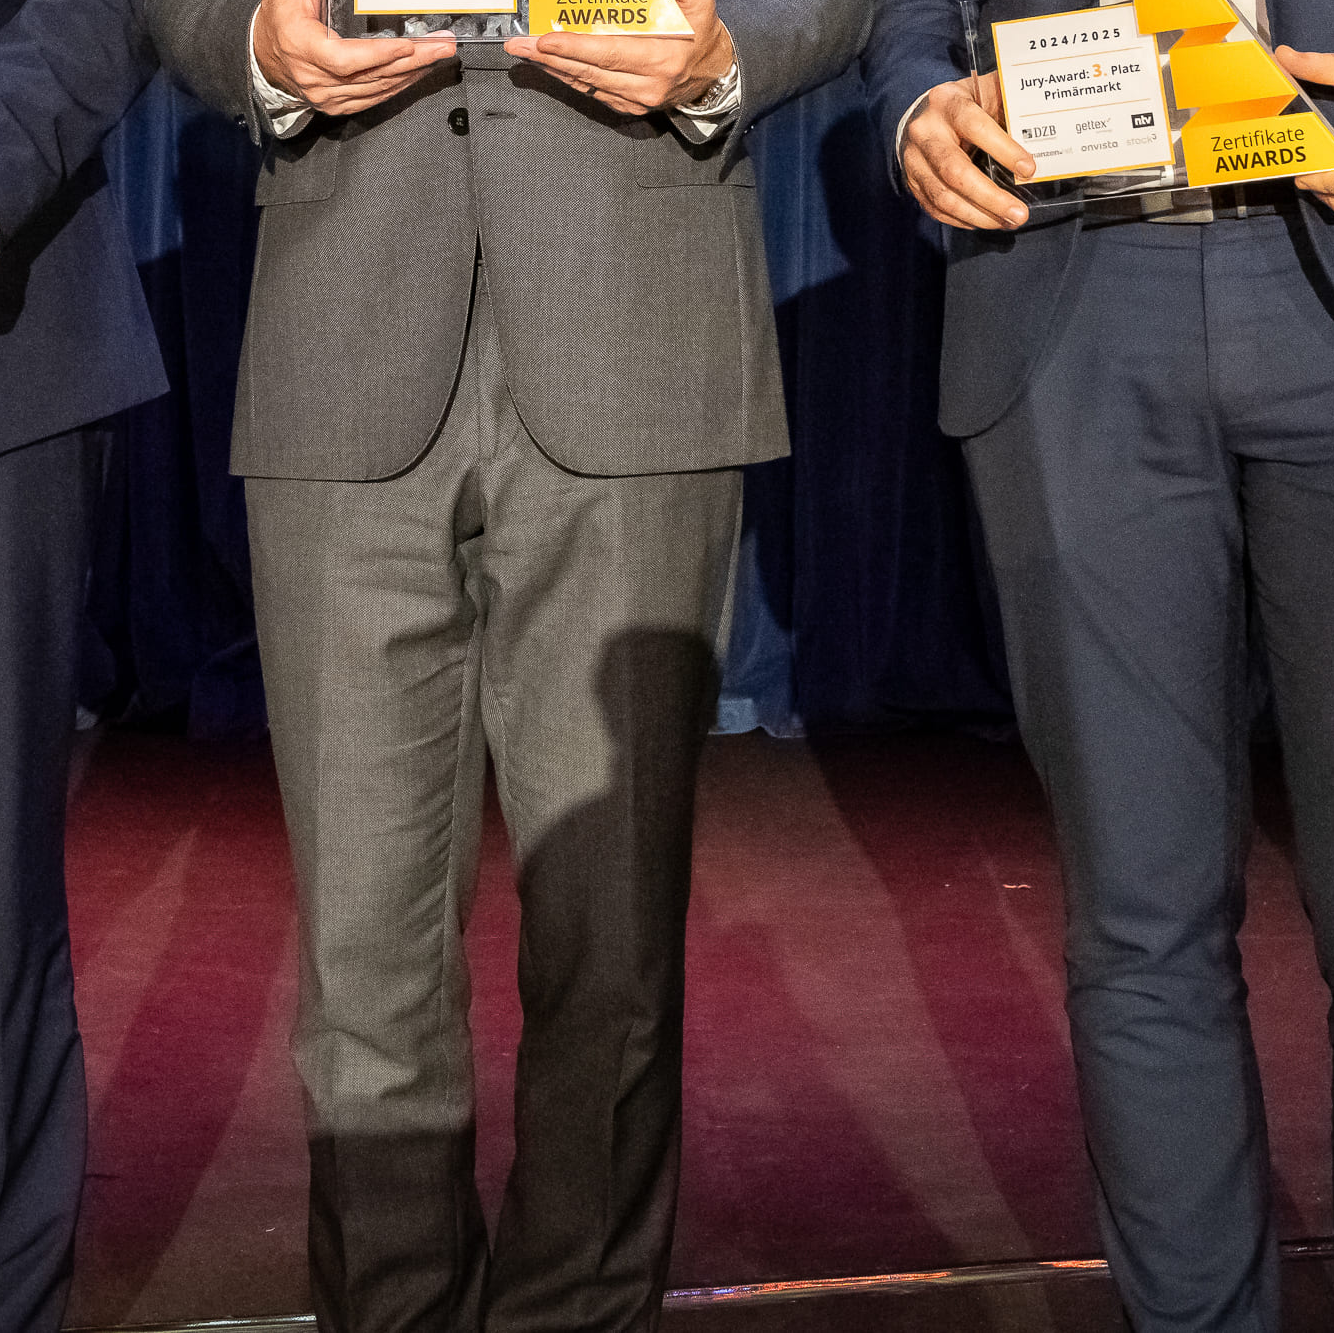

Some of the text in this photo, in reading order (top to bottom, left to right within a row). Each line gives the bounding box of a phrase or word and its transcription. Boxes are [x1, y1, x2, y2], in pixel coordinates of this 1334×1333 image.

[557, 8, 647, 25] AWARDS
[1029, 27, 1121, 51] 2024/2025
[1020, 62, 1141, 91] Jury-Award: 3. Platz
[1044, 81, 1122, 101] Primärmarkt
[1033, 124, 1057, 138] DZB
[1134, 114, 1152, 126] ntv
[1211, 127, 1305, 152] Zertifikate
[1215, 146, 1307, 173] AWARDS
